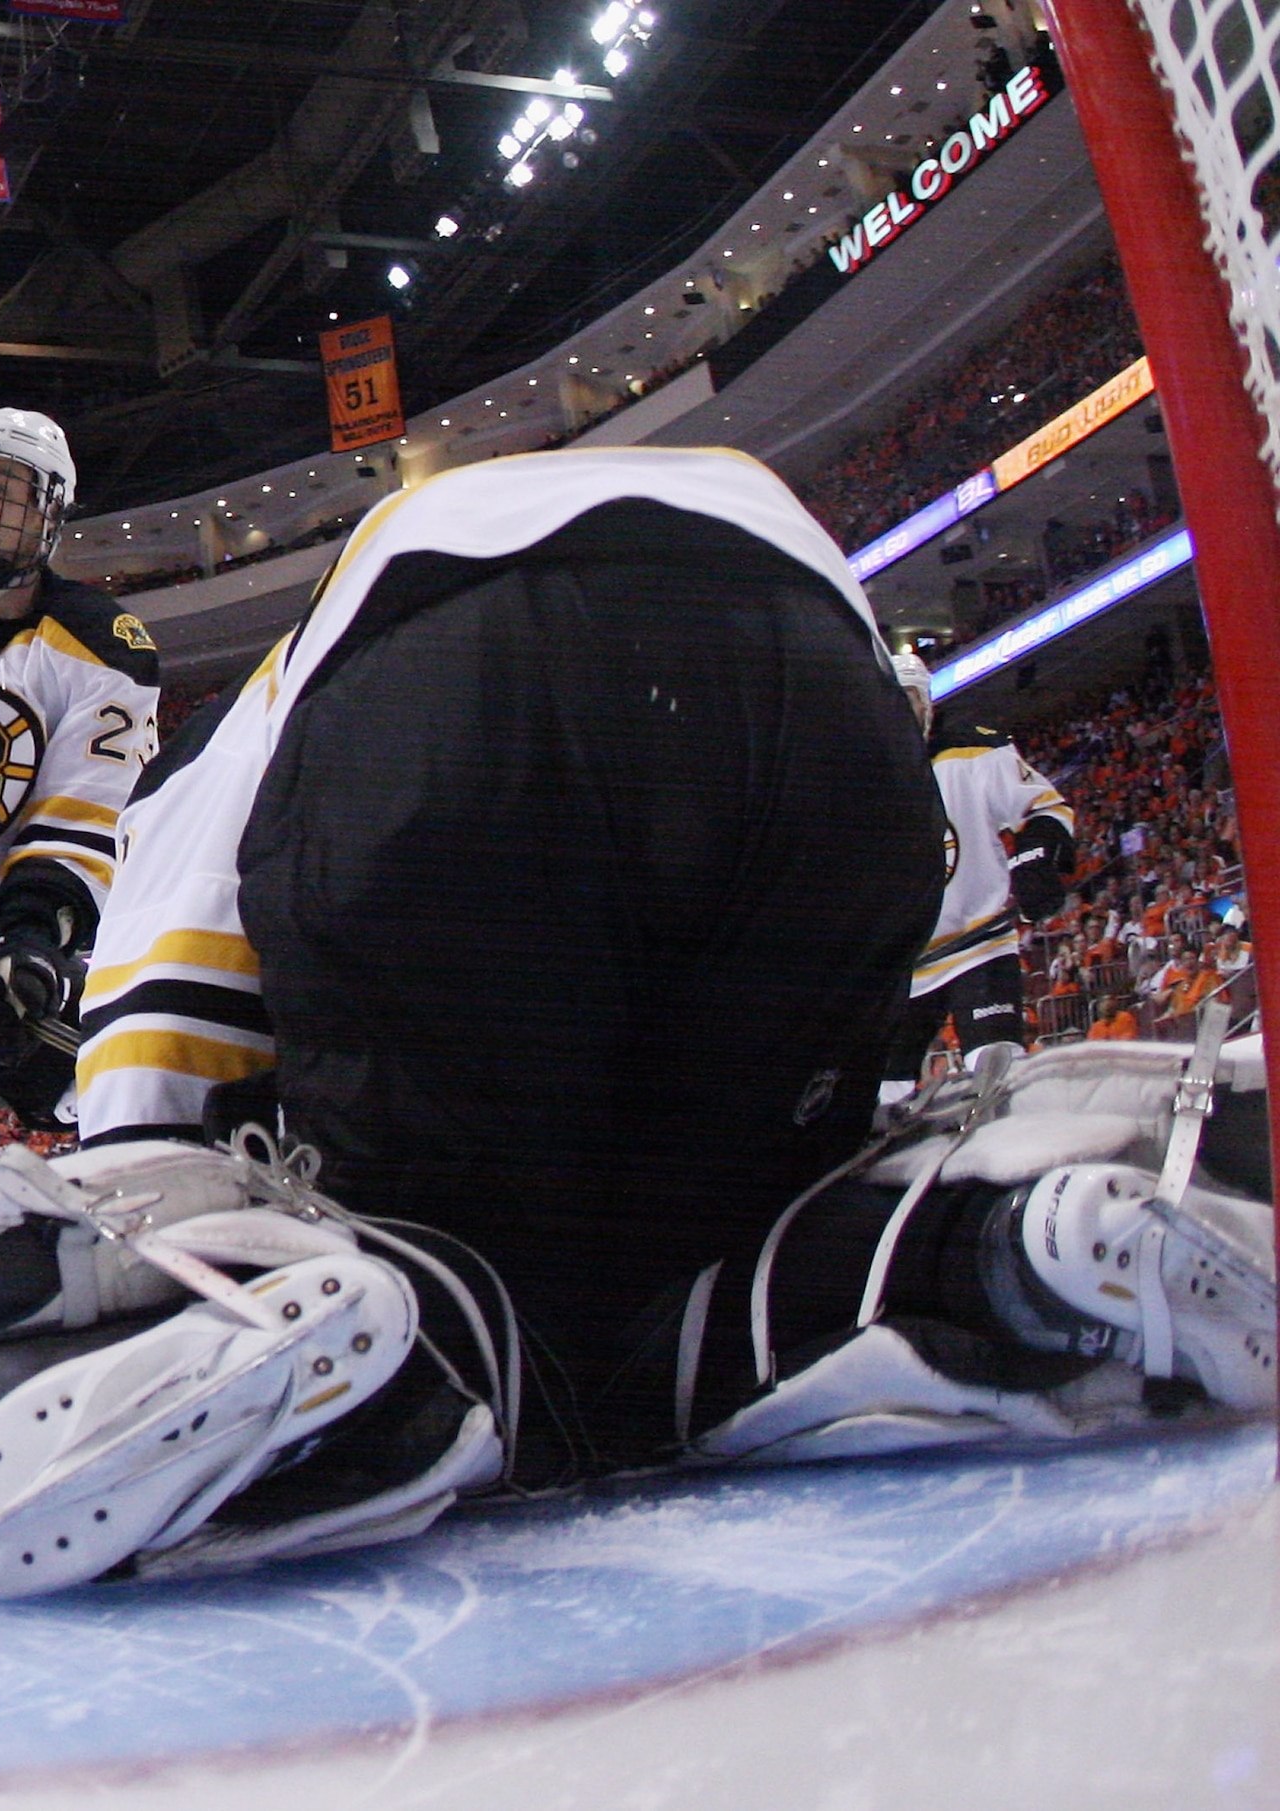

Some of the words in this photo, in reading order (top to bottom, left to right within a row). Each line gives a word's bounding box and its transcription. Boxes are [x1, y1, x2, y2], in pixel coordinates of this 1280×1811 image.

[827, 65, 1050, 274] WELCOME
[344, 377, 379, 411] 51
[1026, 423, 1071, 467] BUD
[1078, 366, 1145, 430] LIGHT
[953, 652, 998, 683] BUD
[1111, 566, 1141, 595] WE
[1140, 549, 1169, 579] GO
